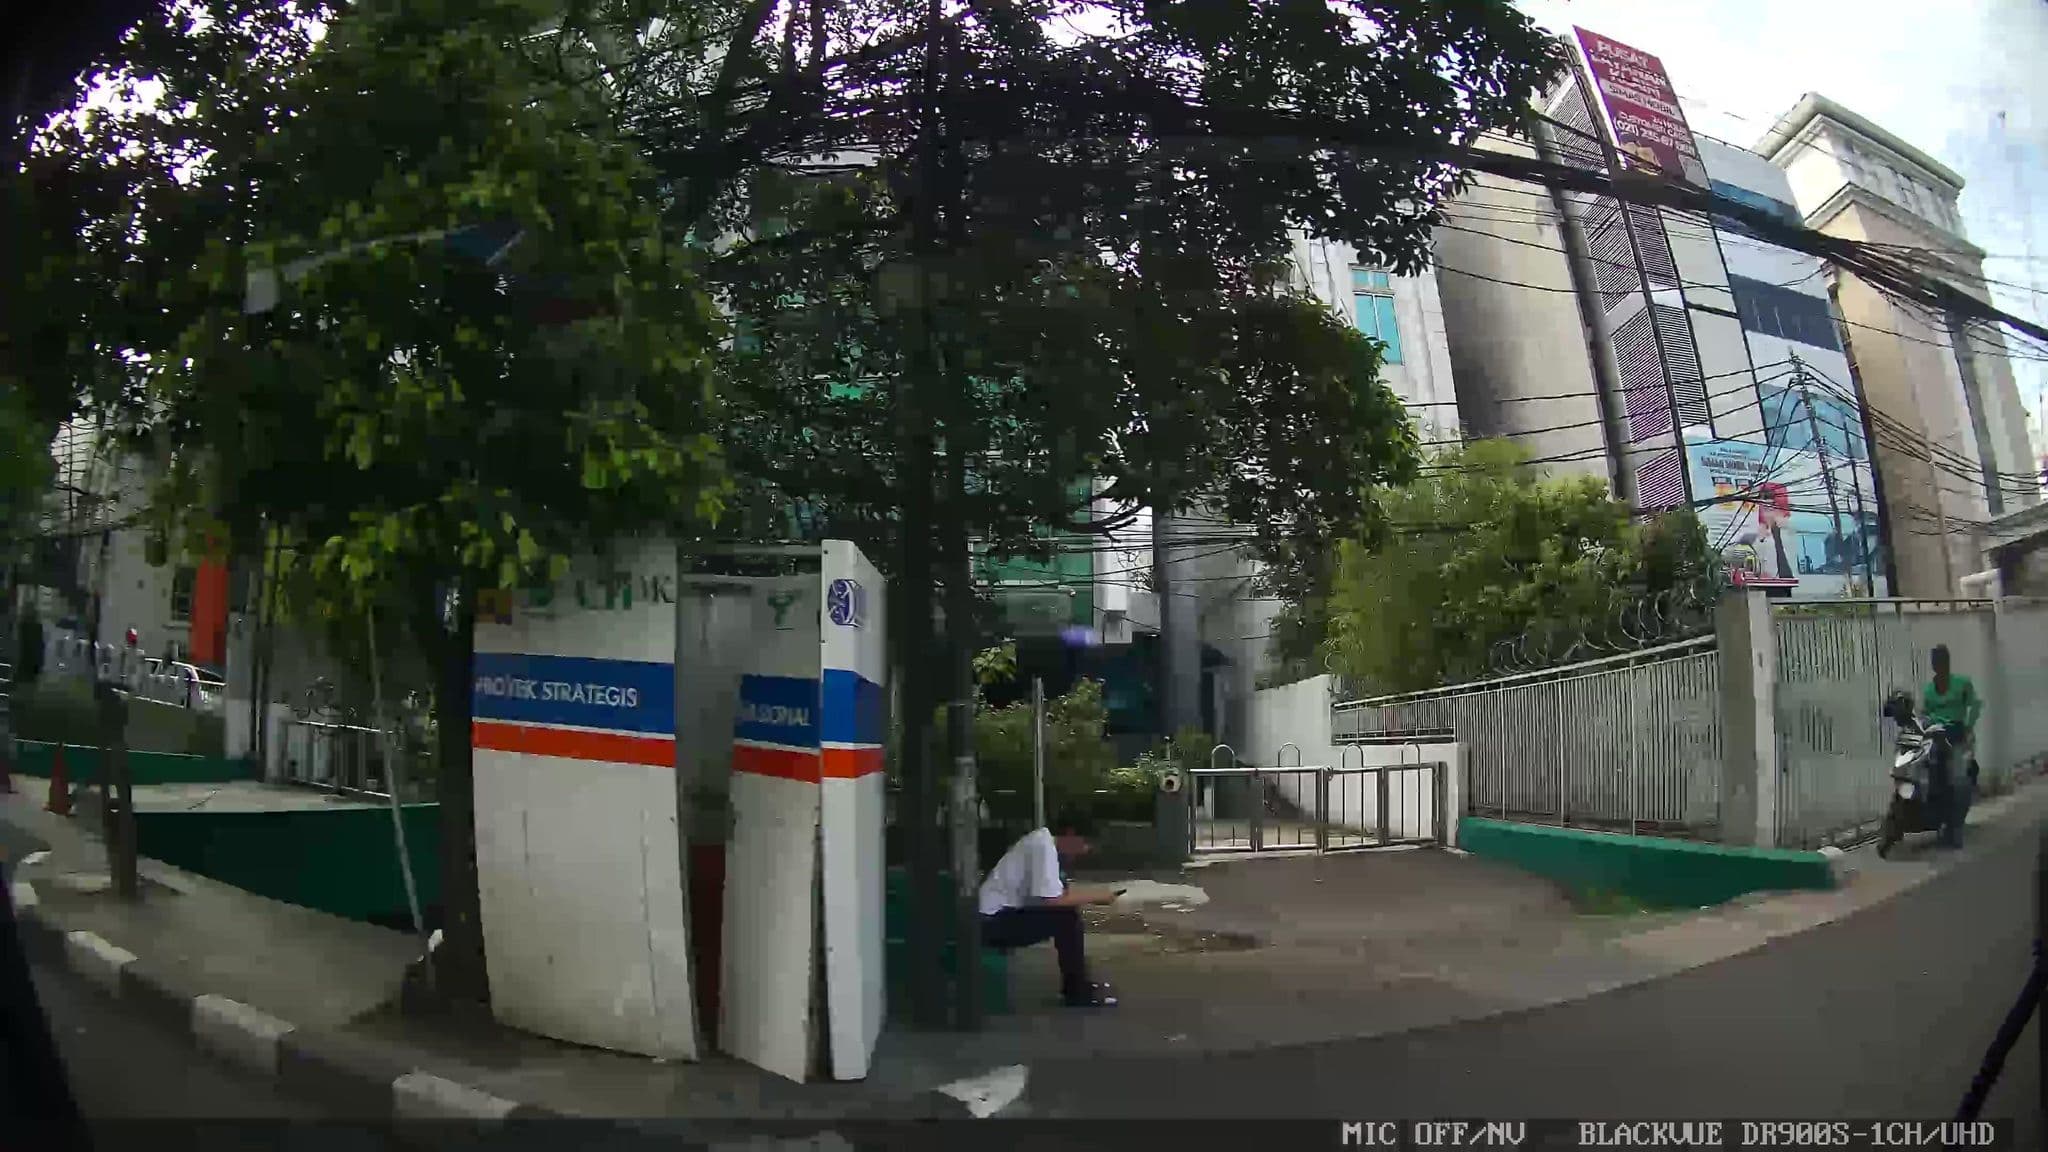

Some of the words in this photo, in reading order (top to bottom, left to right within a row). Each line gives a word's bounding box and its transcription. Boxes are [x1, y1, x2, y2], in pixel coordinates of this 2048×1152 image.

[1597, 41, 1649, 67] PUSAT
[1613, 117, 1639, 137] (021)
[540, 680, 640, 708] STRATEGIS
